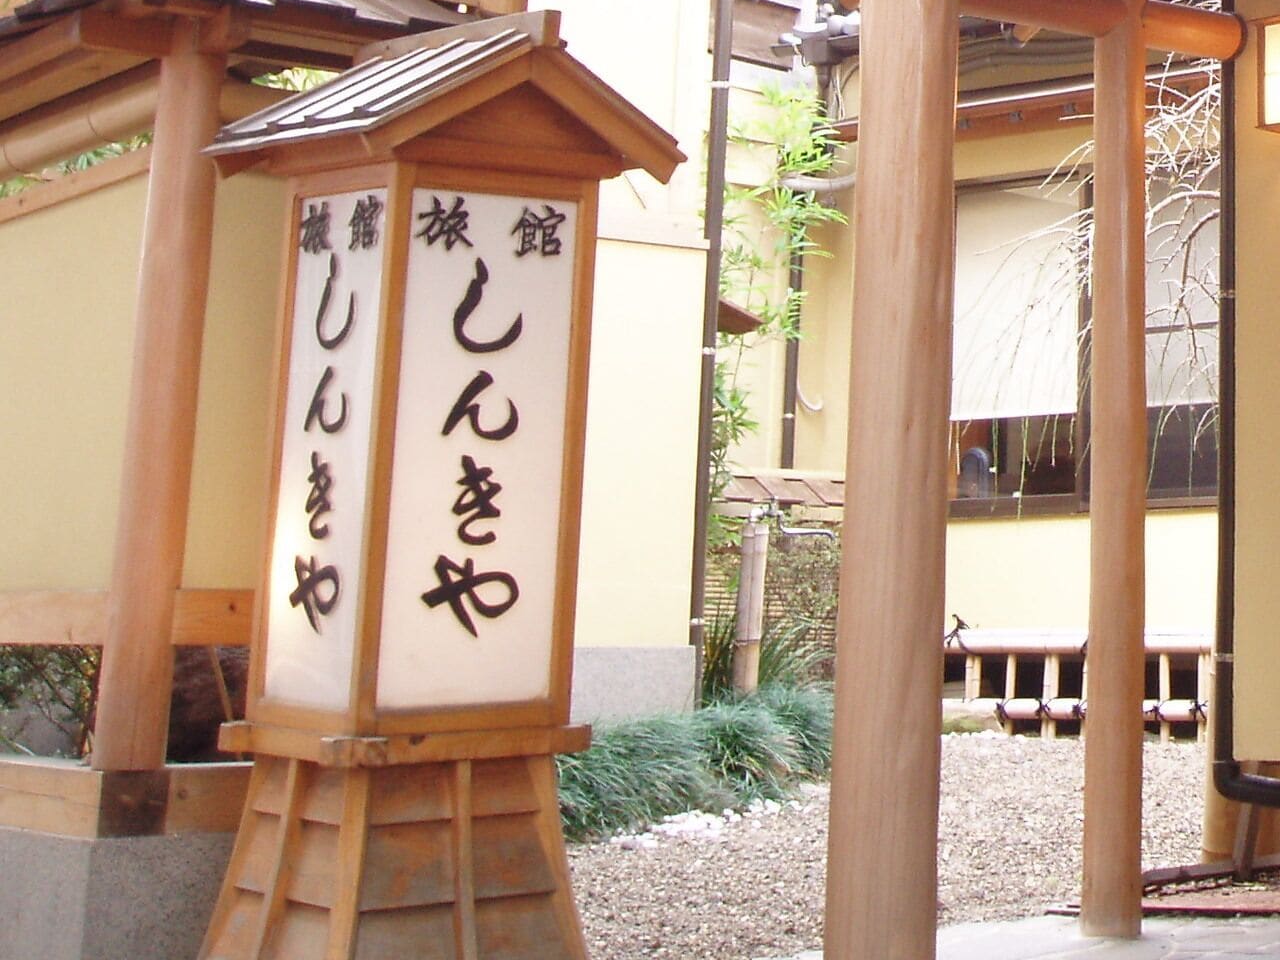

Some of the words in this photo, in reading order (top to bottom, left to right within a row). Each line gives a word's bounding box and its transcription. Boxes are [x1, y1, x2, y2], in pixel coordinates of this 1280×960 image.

[300, 194, 384, 254] 旅館
[416, 195, 567, 258] 旅館
[289, 251, 356, 635] しんきや
[420, 256, 523, 638] しんきや
